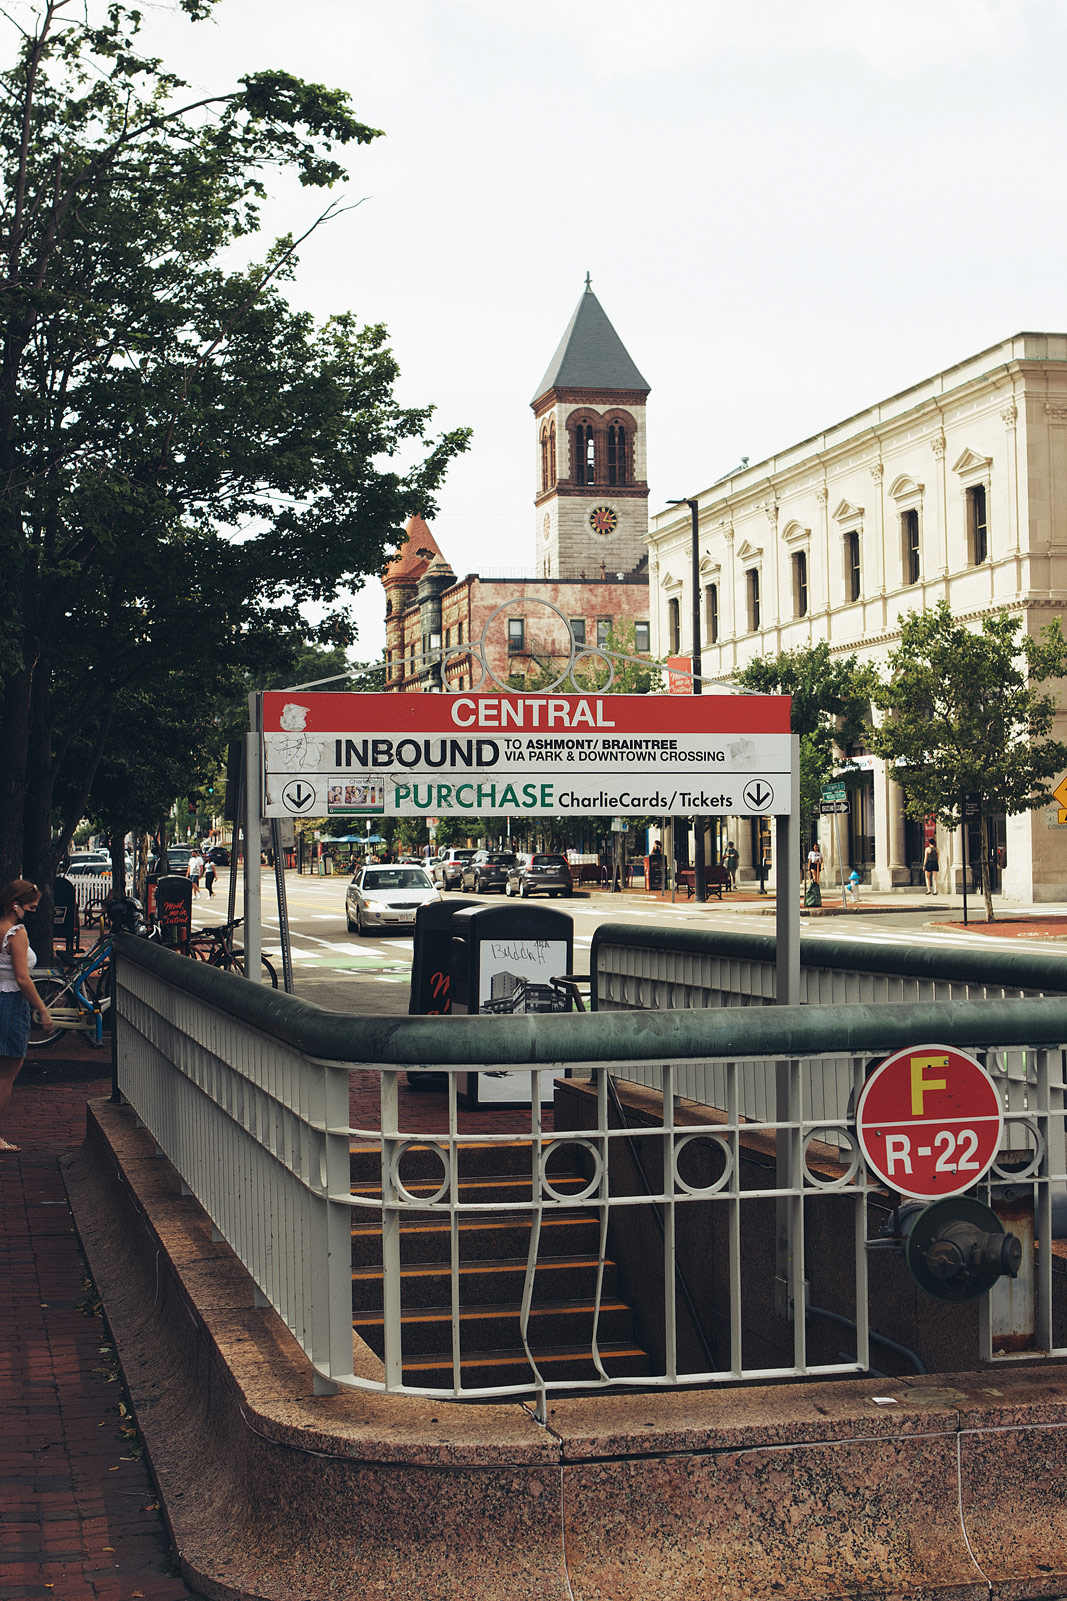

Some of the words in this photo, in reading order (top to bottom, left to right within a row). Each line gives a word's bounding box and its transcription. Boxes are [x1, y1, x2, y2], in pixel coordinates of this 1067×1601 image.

[669, 685, 692, 693] Central
[450, 698, 616, 728] CENTRAL
[335, 738, 500, 768] INBOUND
[504, 739, 522, 750] TO
[526, 738, 598, 751] ASHMONT/
[602, 739, 678, 750] BRAINTREE
[504, 751, 525, 762] VIA
[528, 751, 563, 762] PARK
[566, 750, 576, 762] &
[578, 750, 657, 762] DOWNTOWN
[660, 750, 725, 762] CROSSING
[394, 782, 554, 809] PURCHASE
[558, 790, 733, 811] CharlieCards/Tickets
[909, 1055, 950, 1116] F
[885, 1128, 980, 1176] R-22
